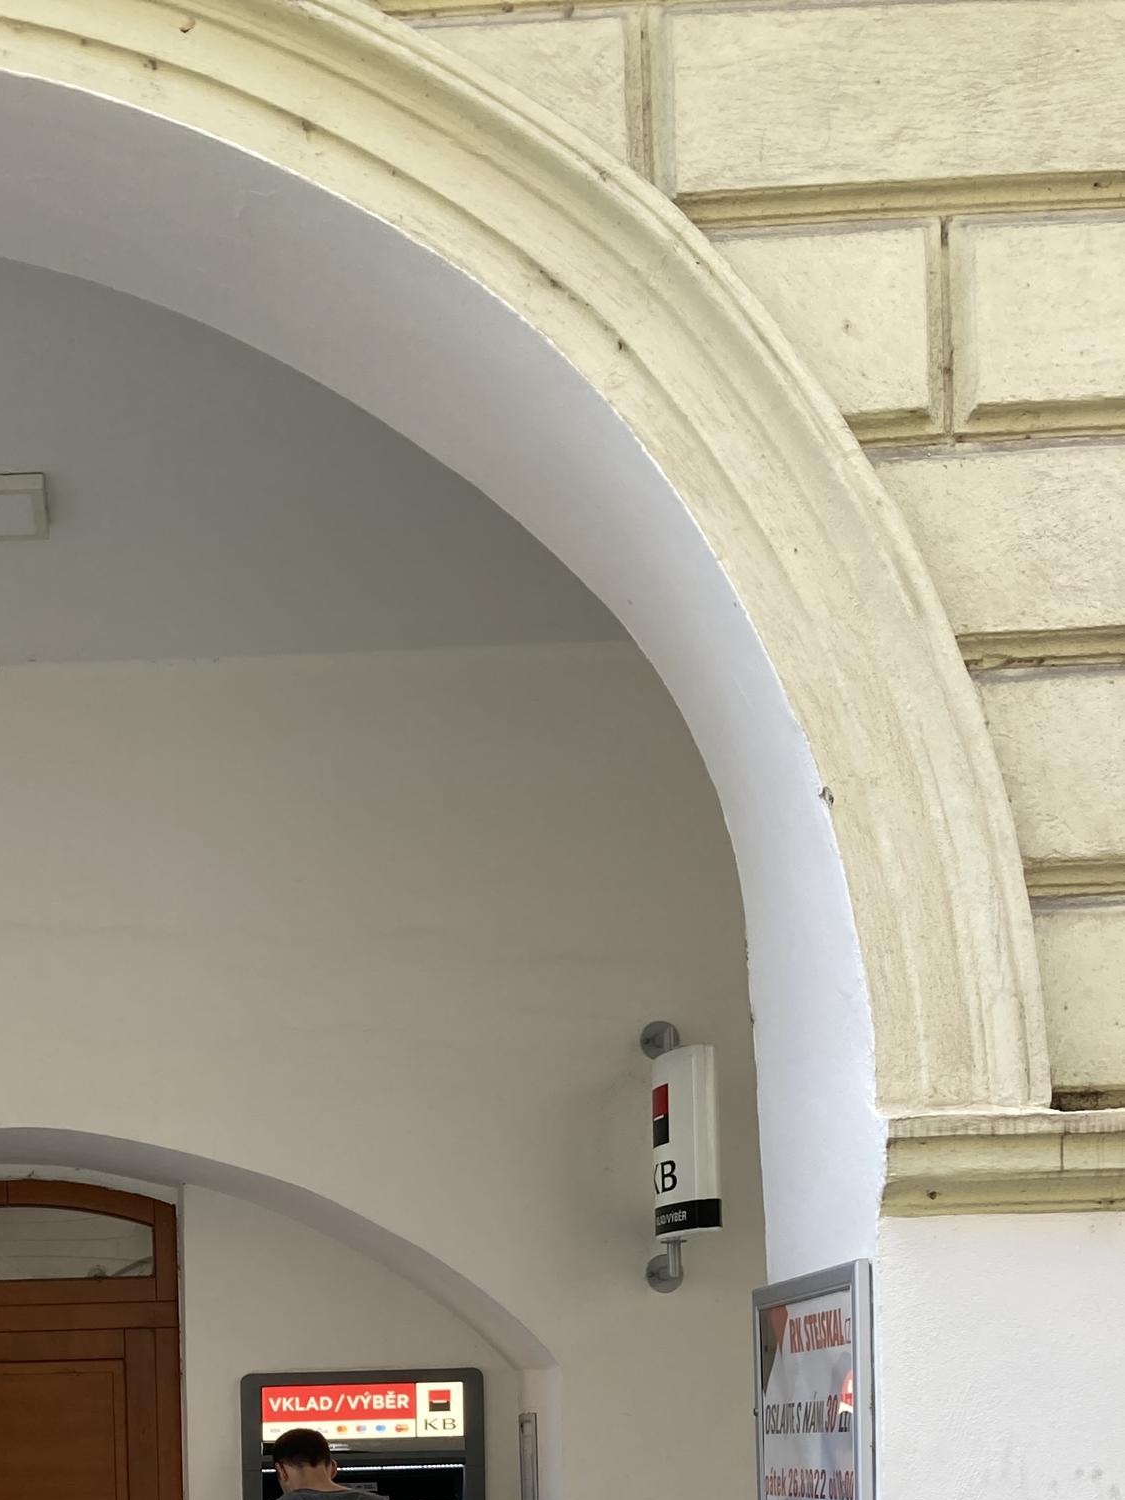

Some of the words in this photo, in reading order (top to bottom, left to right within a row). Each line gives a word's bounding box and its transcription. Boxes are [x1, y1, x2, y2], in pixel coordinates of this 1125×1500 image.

[789, 1317, 804, 1353] RK
[424, 1418, 457, 1431] KB
[796, 1402, 802, 1433] S
[825, 1394, 839, 1433] 30
